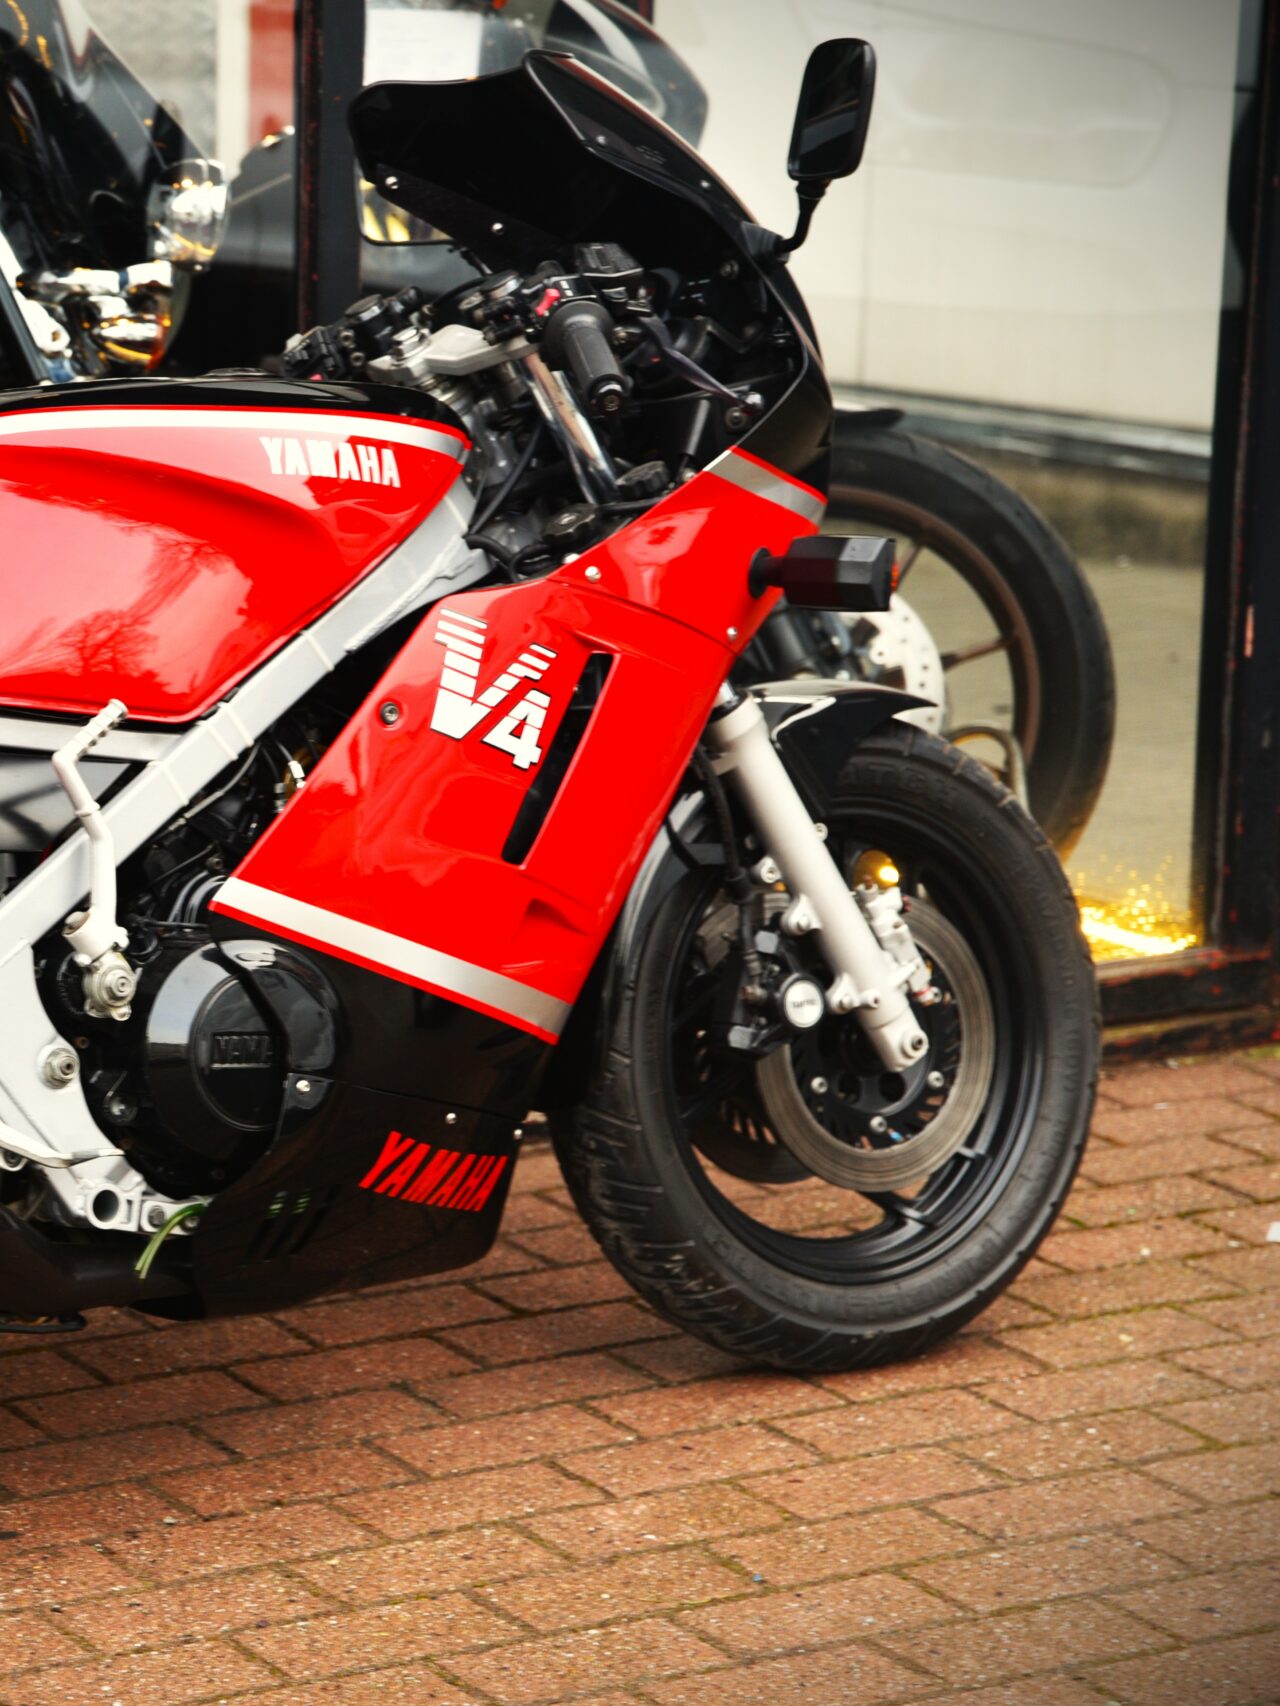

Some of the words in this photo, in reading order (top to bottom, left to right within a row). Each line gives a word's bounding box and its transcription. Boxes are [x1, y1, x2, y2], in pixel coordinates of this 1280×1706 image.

[259, 436, 401, 488] YAMAHA
[429, 607, 558, 770] V4
[358, 1130, 509, 1213] YAMAHA
